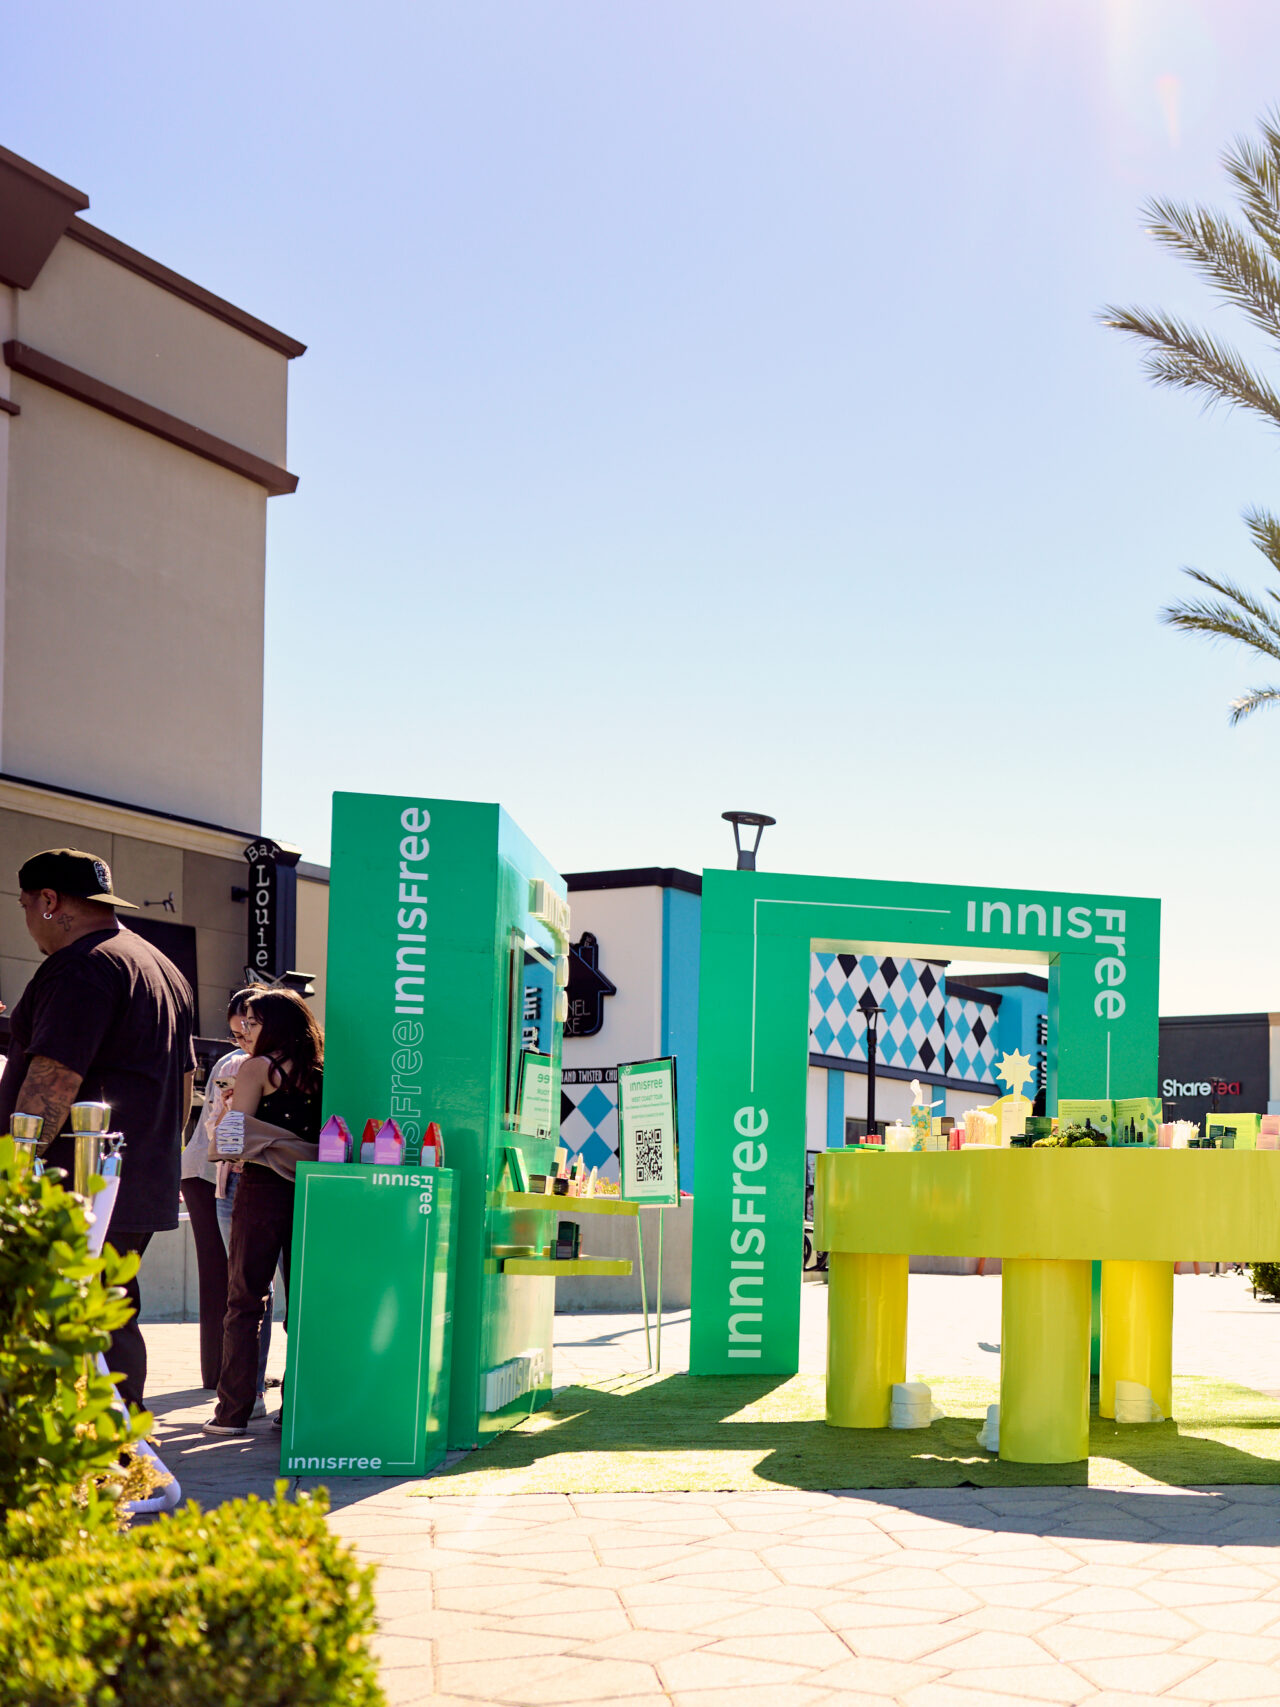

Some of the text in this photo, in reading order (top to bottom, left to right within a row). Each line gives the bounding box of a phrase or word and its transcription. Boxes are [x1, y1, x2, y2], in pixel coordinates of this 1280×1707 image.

[246, 844, 280, 967] Bar Louie
[578, 1070, 602, 1083] TWISTED
